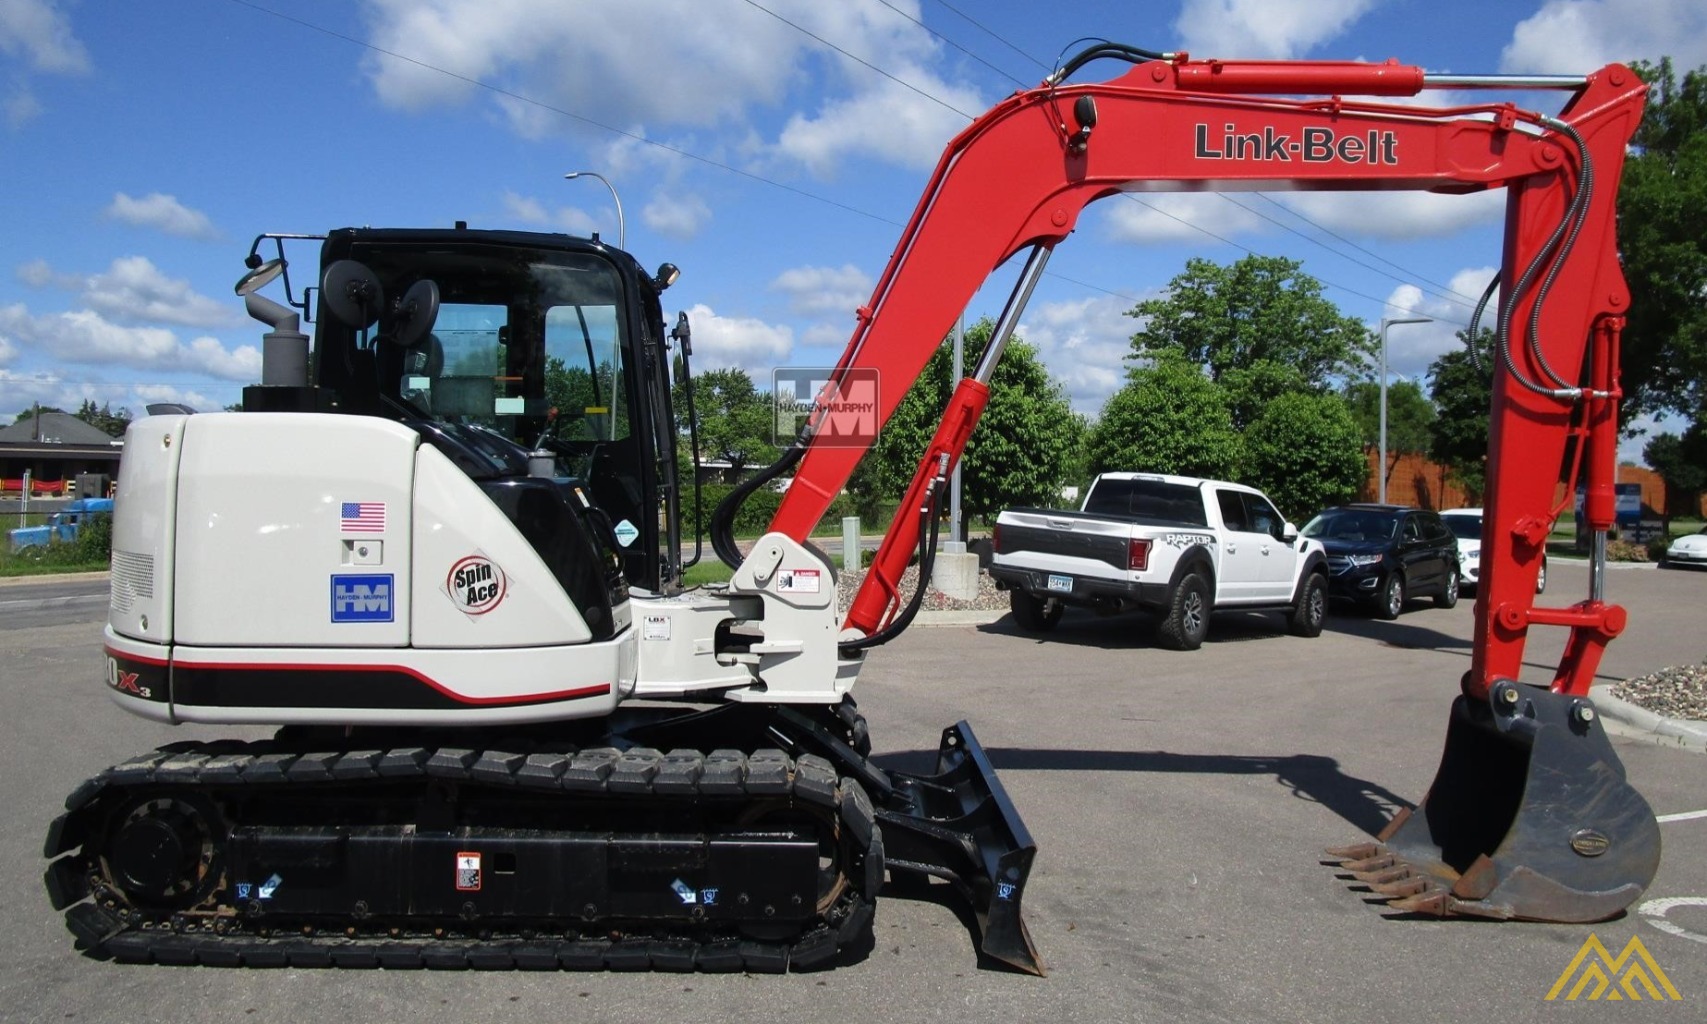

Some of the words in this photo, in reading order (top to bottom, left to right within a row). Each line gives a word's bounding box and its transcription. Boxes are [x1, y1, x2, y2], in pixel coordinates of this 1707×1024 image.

[1195, 123, 1398, 165] Link-Belt
[1166, 533, 1213, 548] RAPTOR
[455, 564, 492, 588] Spin
[466, 583, 499, 605] Ace
[648, 616, 666, 624] LBX
